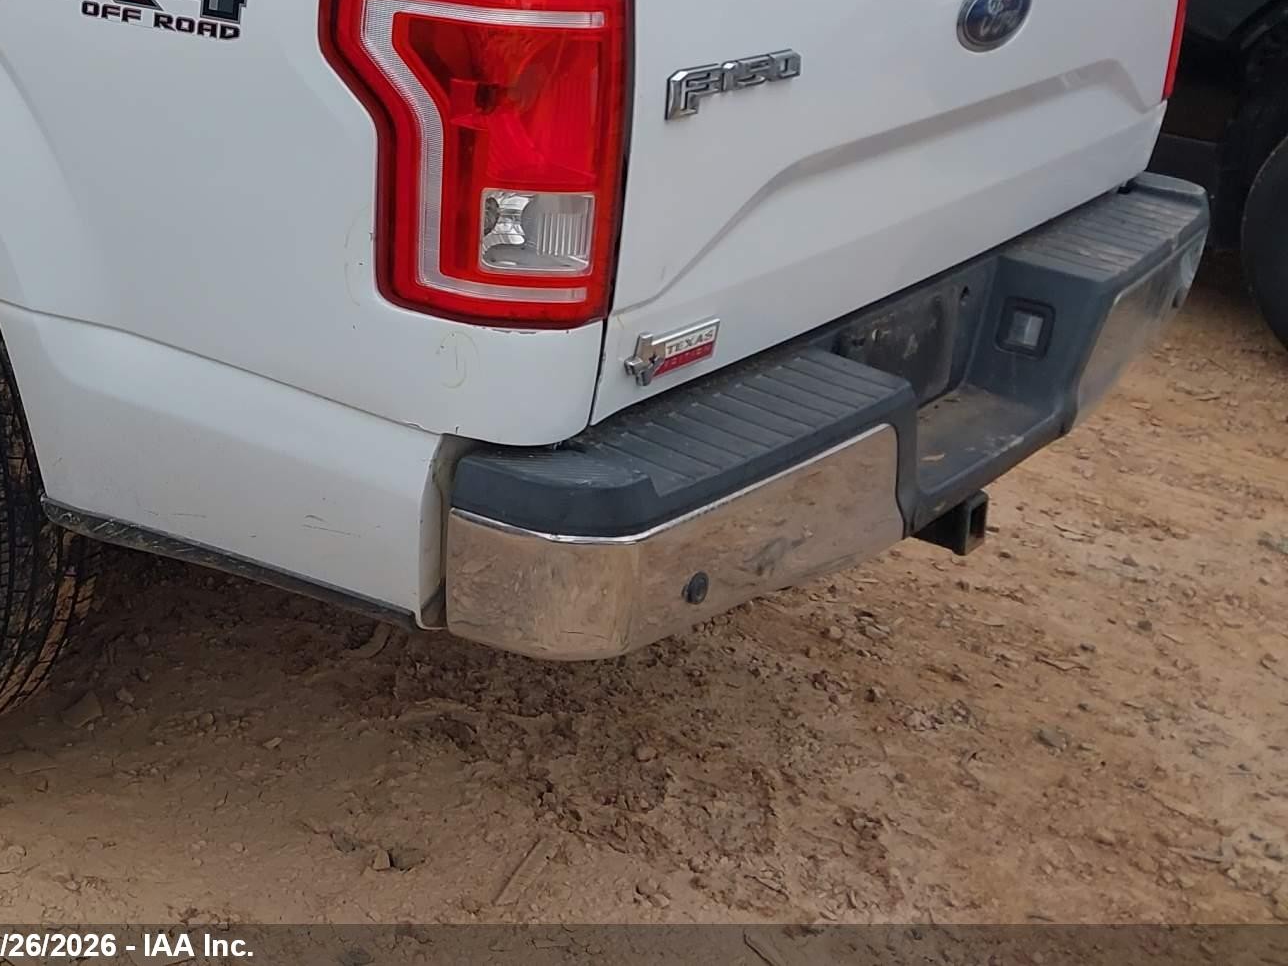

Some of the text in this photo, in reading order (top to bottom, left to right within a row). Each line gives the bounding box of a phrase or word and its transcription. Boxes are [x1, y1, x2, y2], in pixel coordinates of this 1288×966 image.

[81, 0, 242, 40] OFF ROAD
[666, 329, 715, 355] TEXAS
